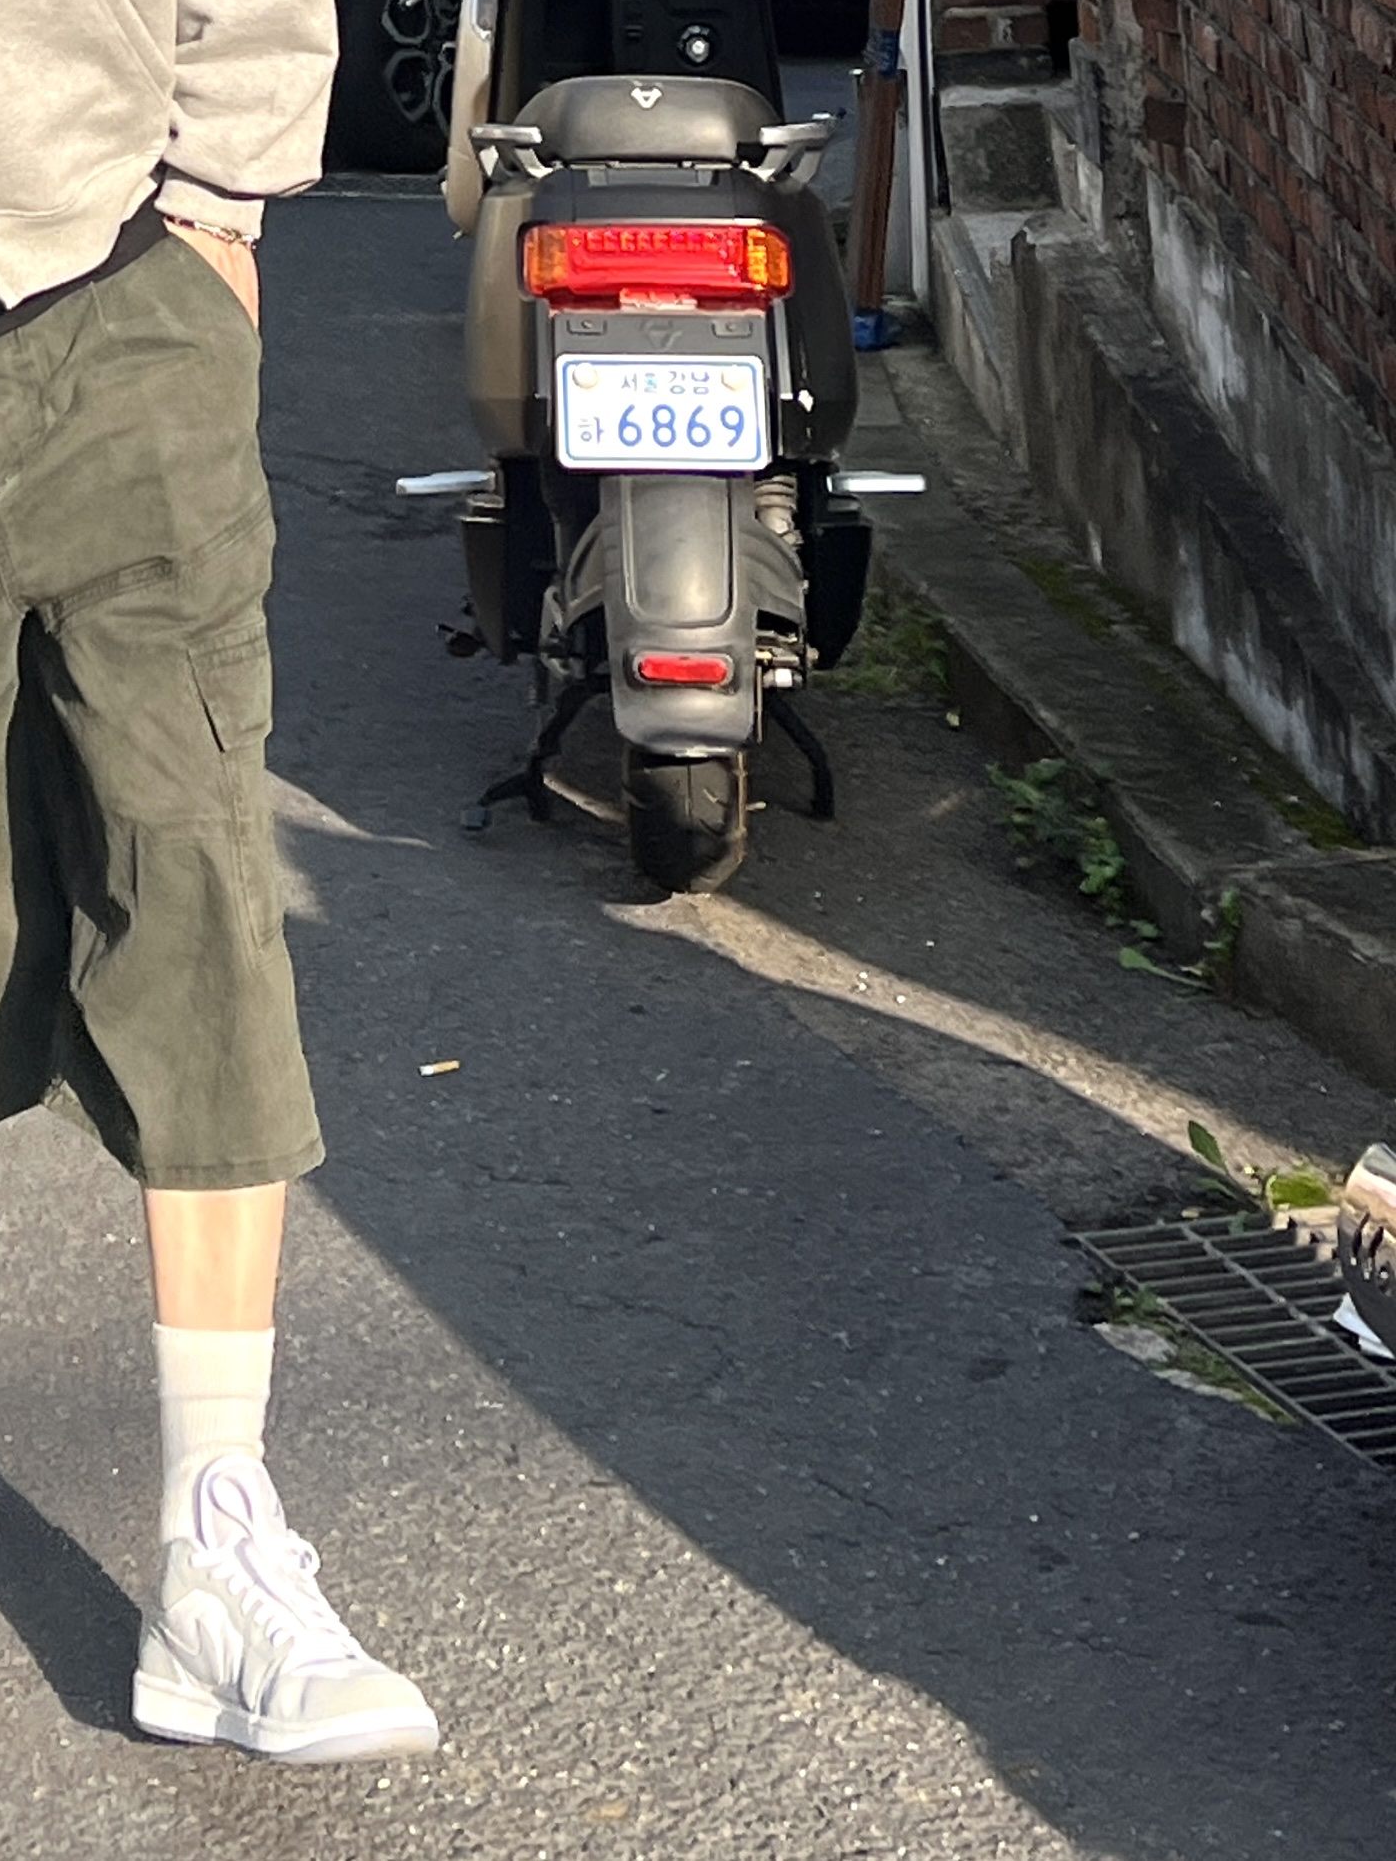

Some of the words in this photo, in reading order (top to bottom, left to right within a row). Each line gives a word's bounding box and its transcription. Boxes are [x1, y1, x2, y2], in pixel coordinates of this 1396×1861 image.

[621, 371, 659, 394] 서울
[669, 370, 711, 395] 강남
[578, 416, 605, 444] 하
[617, 403, 746, 448] 6869
